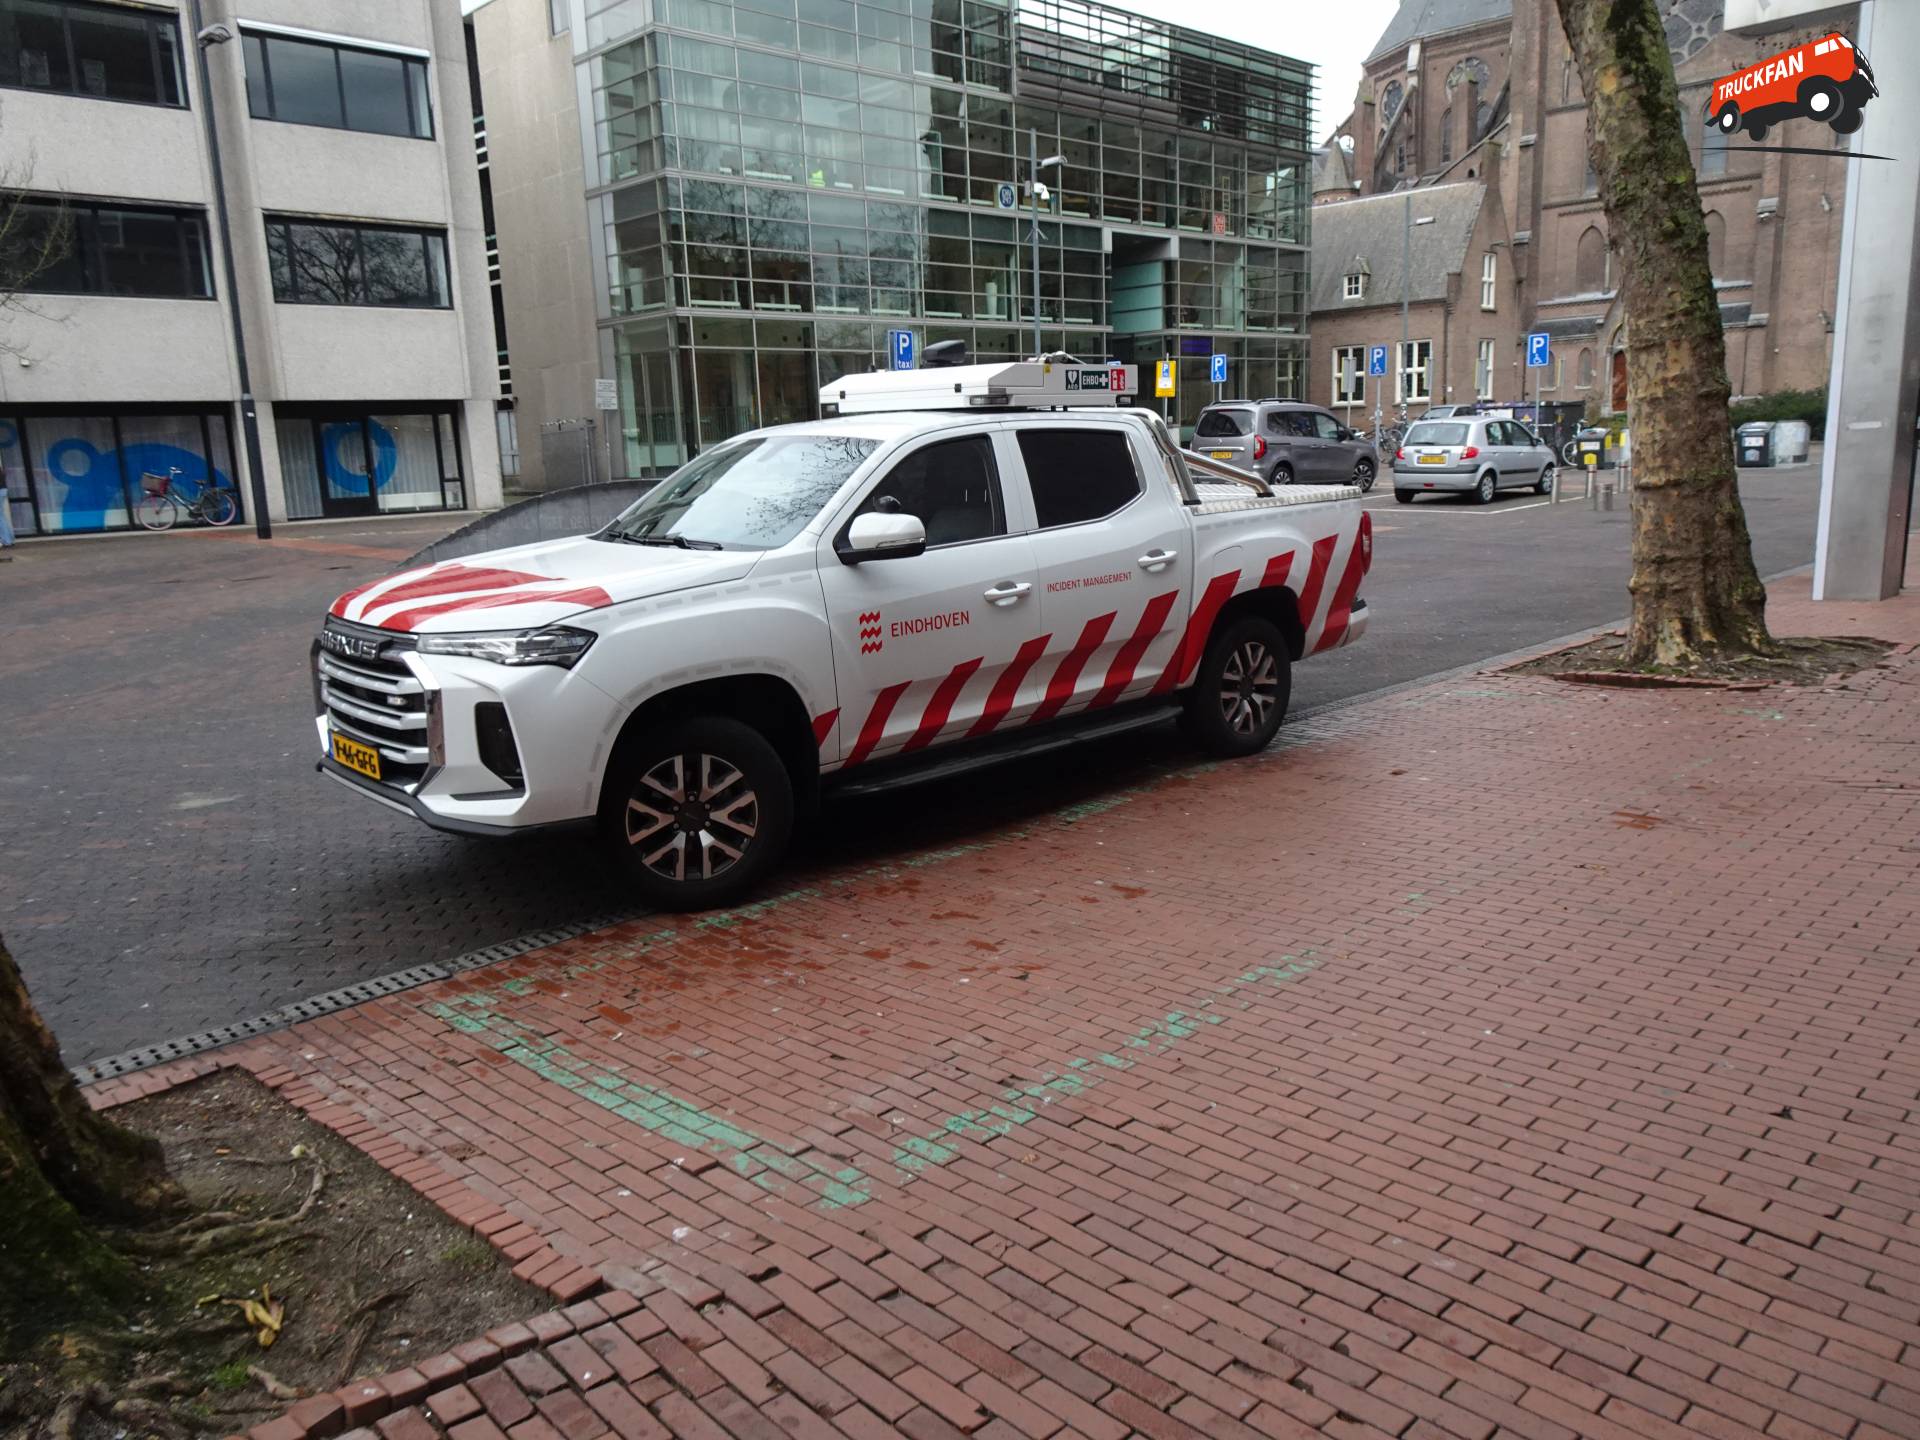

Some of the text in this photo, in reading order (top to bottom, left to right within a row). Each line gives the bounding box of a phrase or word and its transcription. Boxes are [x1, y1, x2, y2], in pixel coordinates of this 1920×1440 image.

[899, 333, 910, 355] P
[1532, 336, 1545, 354] P
[898, 359, 913, 369] taxi
[1214, 357, 1224, 371] P
[1373, 348, 1383, 363] P
[1082, 375, 1099, 385] EHBO
[1047, 571, 1132, 593] INCIDENT MANAGEMENT
[891, 610, 970, 637] EINDHOVEN
[320, 630, 377, 659] MAXUS
